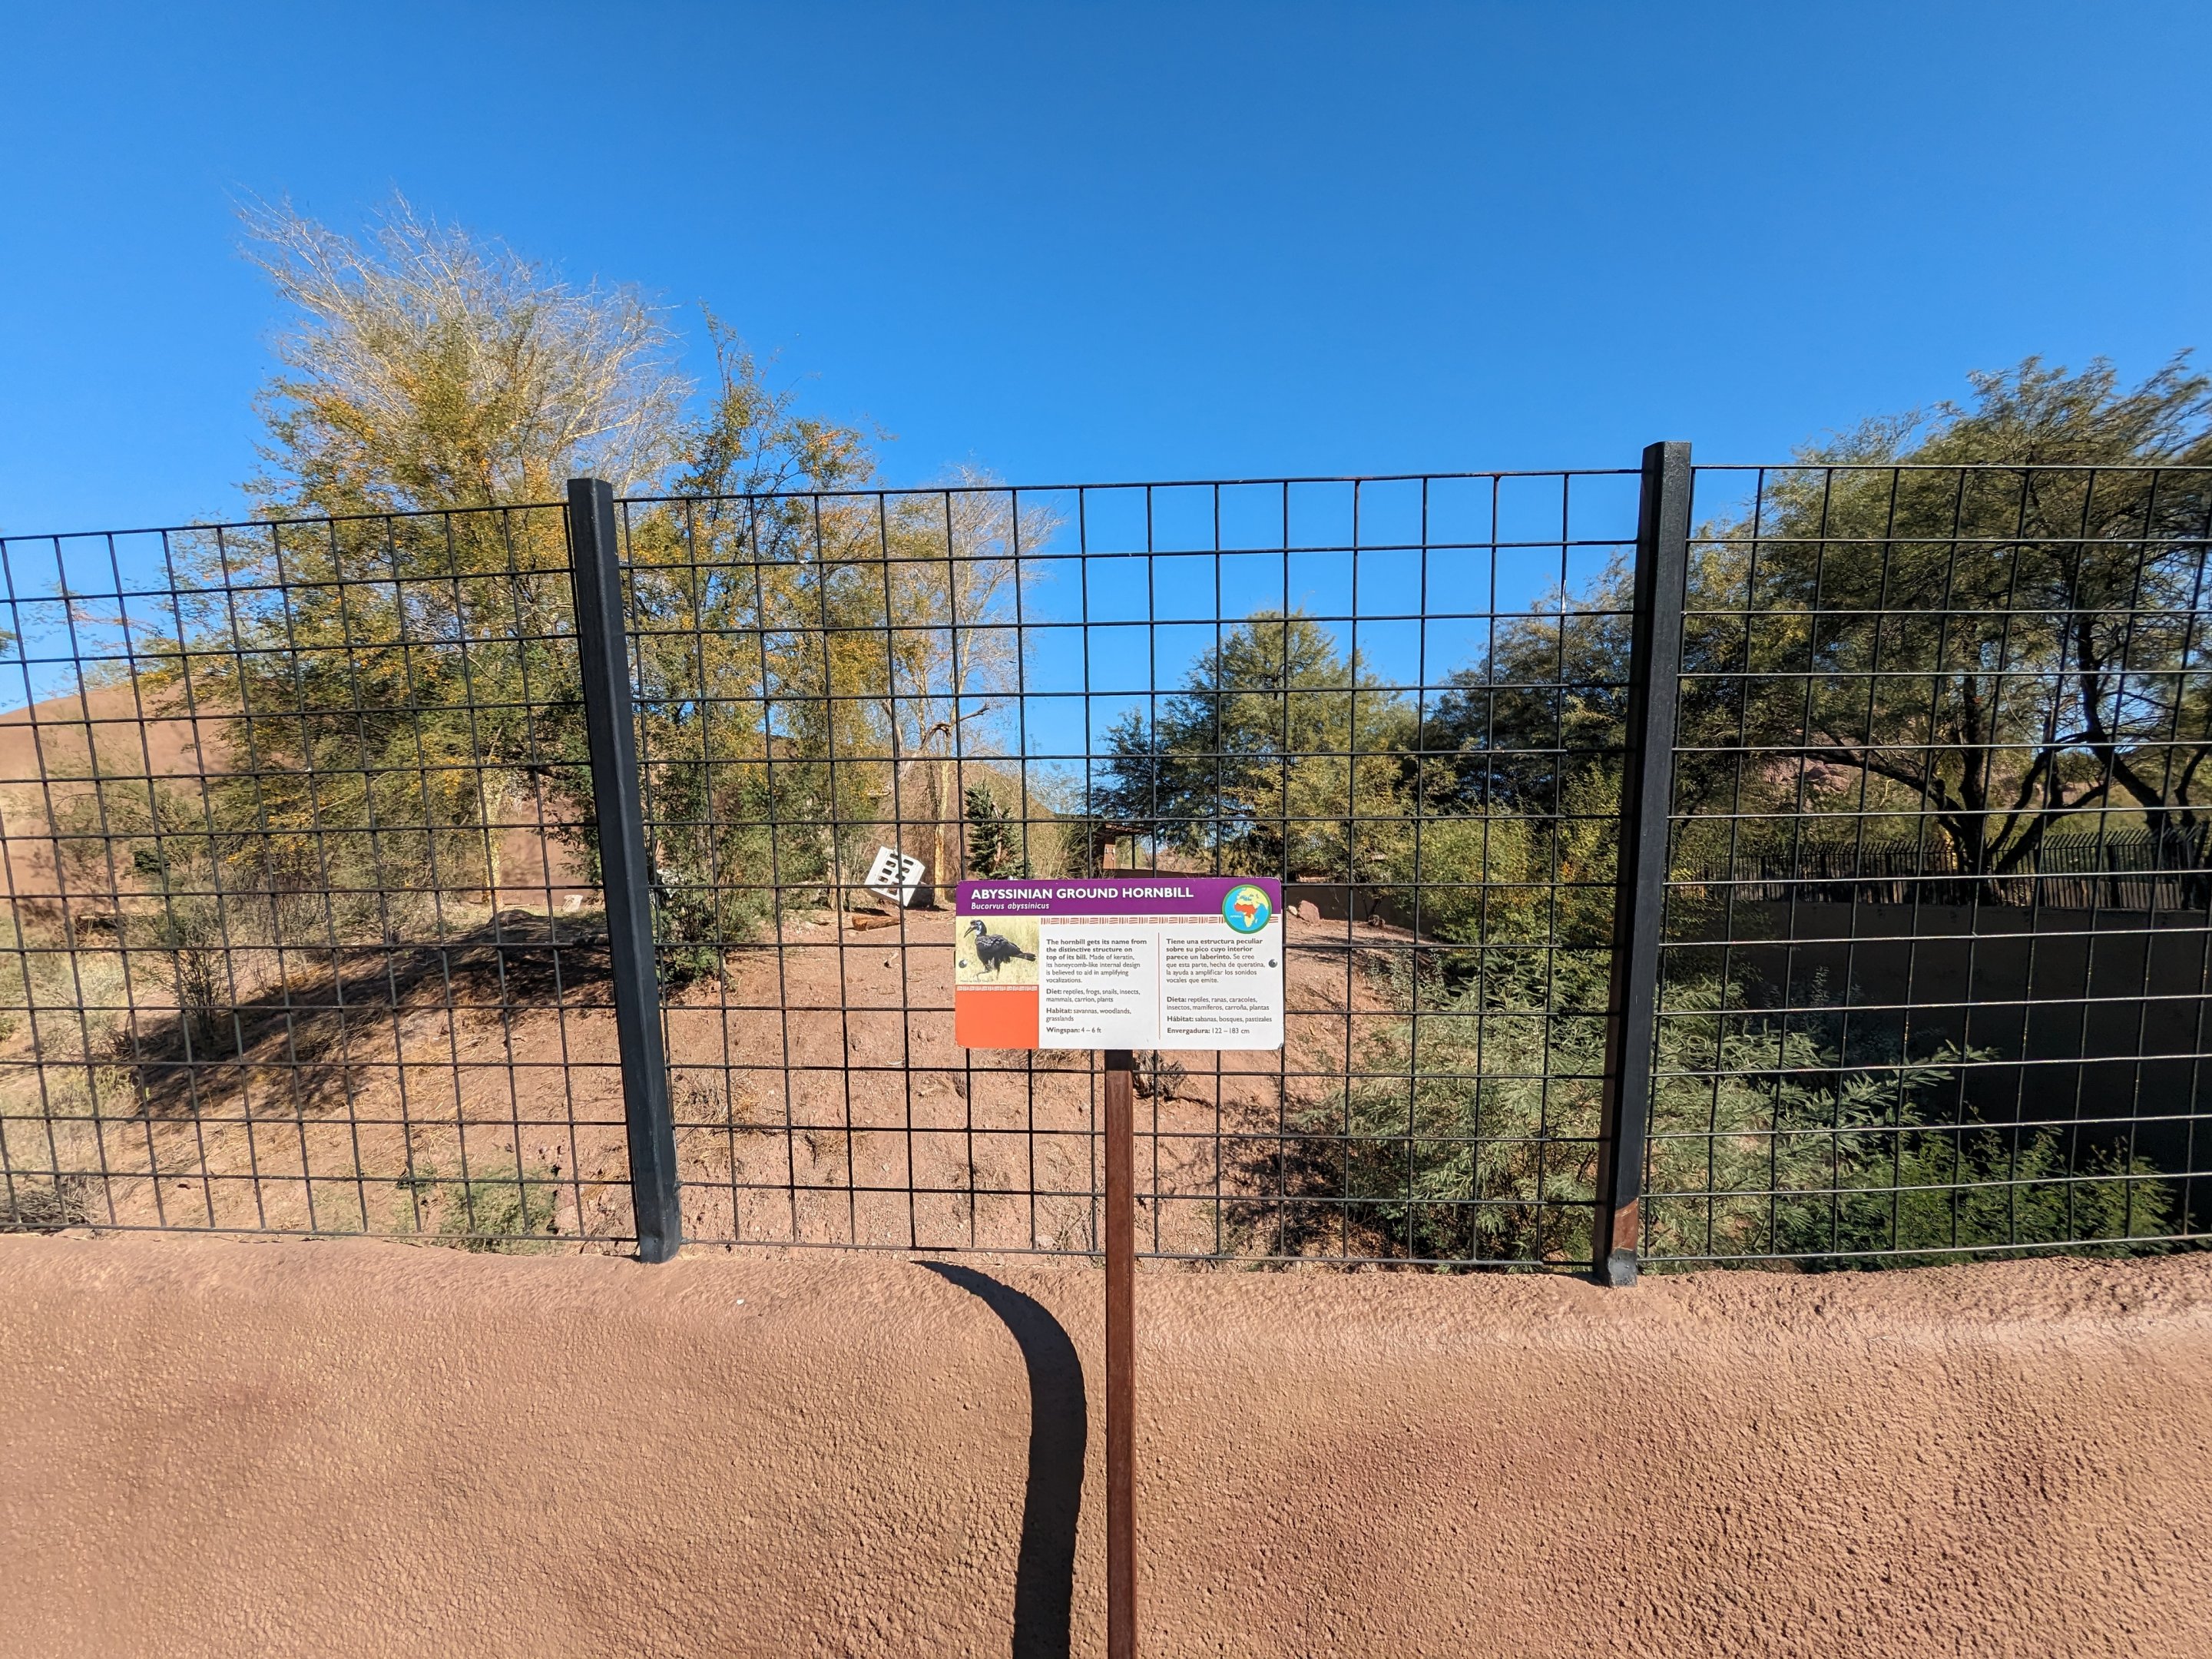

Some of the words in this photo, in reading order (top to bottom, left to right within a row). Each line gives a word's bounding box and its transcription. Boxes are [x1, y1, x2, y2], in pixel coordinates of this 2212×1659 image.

[972, 889, 1052, 899] ABYSSINIAN
[1056, 888, 1118, 899] GROUND
[1123, 887, 1194, 898] HORNBILL
